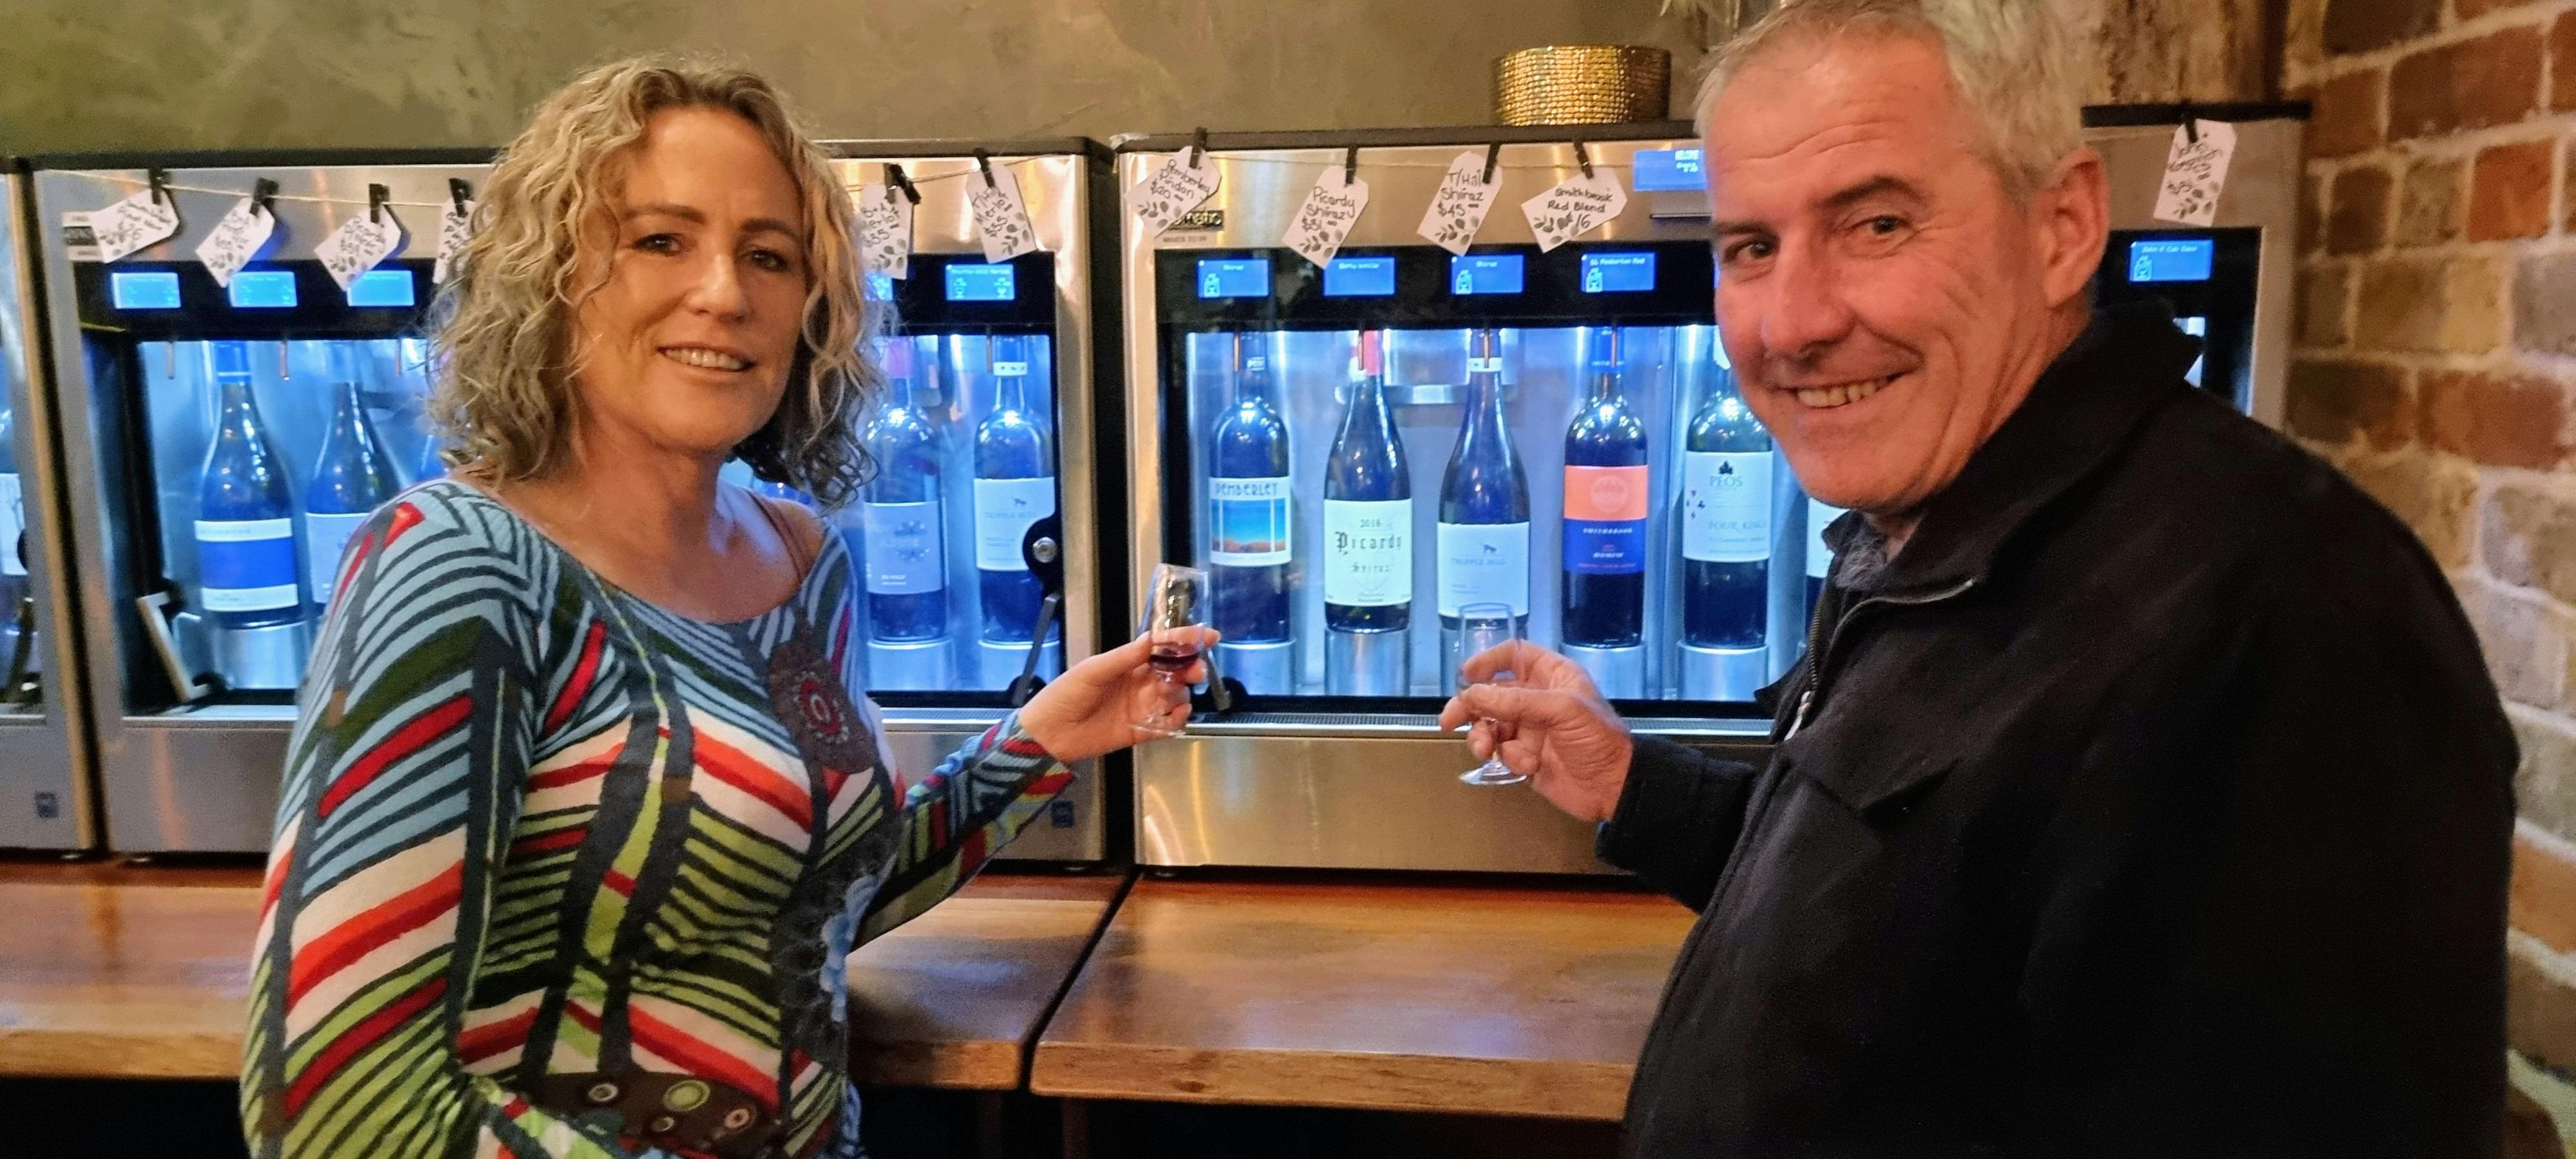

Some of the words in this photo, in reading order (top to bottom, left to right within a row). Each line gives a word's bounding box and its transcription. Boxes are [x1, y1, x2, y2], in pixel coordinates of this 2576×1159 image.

[1440, 187, 1484, 202] Shiraz
[1313, 186, 1356, 219] Picardy
[1547, 200, 1569, 211] Red
[1573, 202, 1606, 214] Blend
[1306, 203, 1345, 220] Shiraz
[1215, 482, 1279, 496] PEMBERLEY
[1709, 476, 1744, 487] PEOS
[1334, 531, 1403, 556] Picardy
